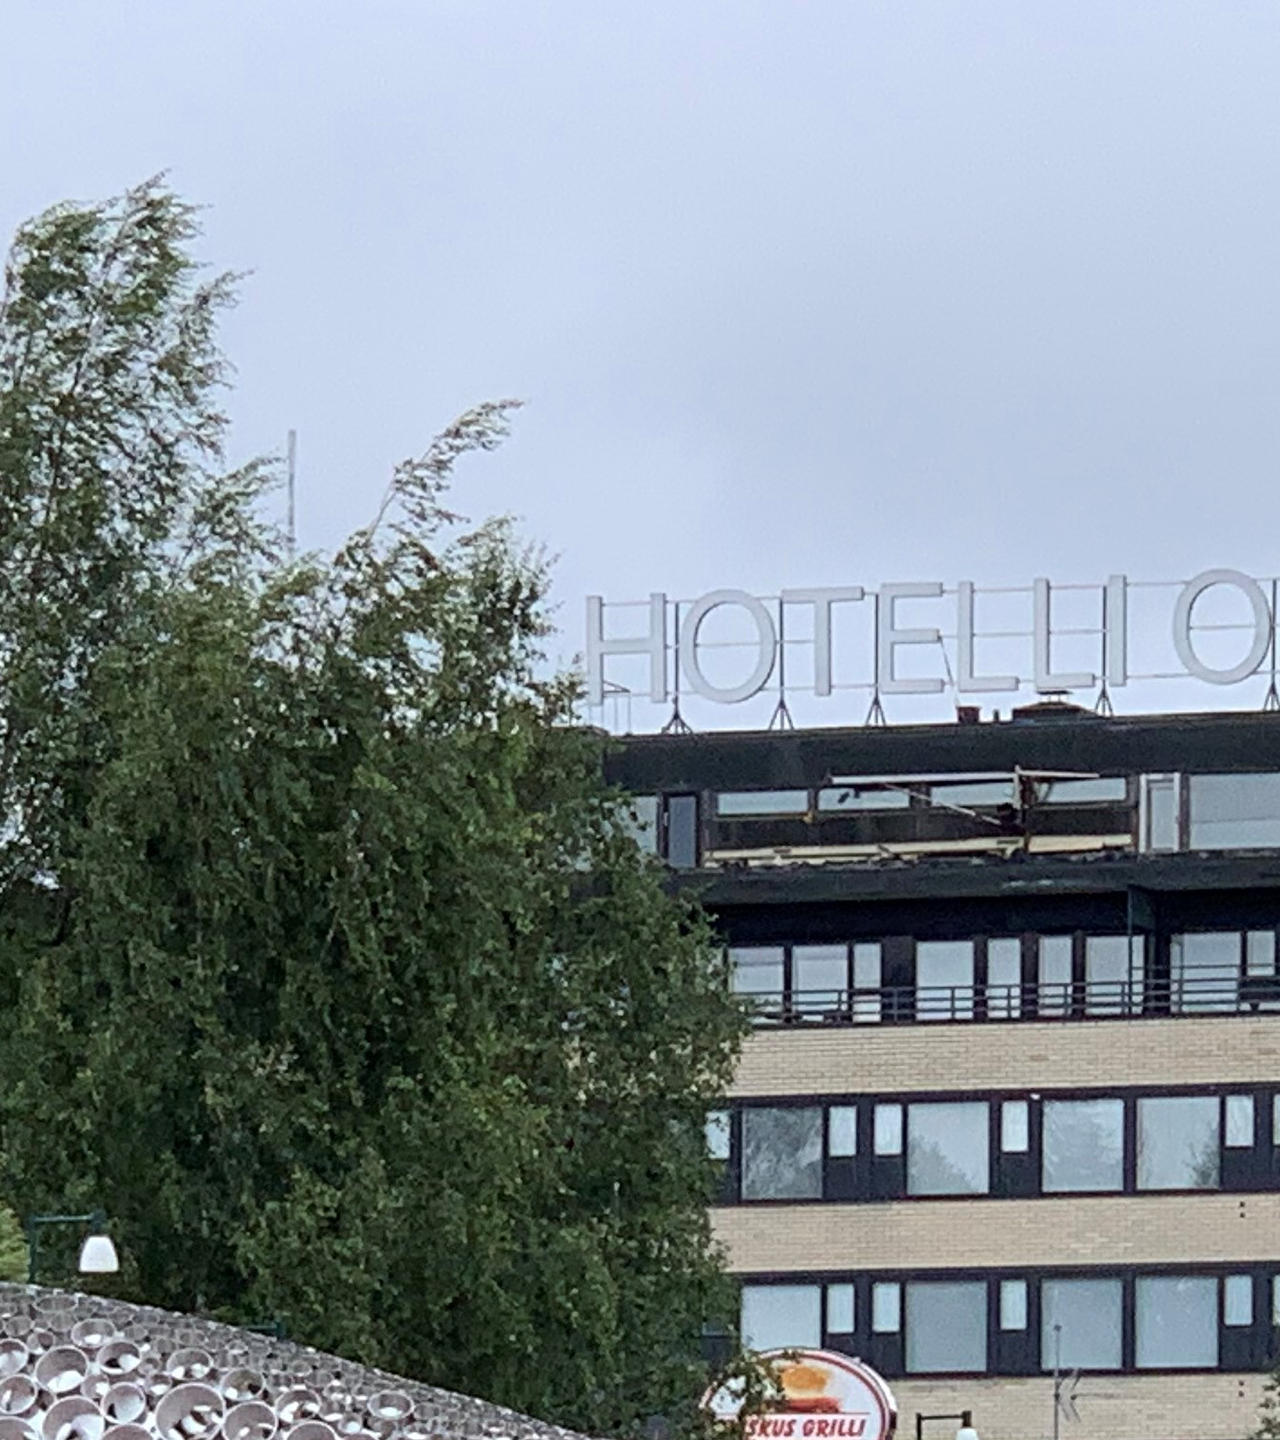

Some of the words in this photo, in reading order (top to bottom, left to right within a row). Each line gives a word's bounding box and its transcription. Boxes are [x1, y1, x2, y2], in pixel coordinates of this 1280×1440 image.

[586, 574, 1128, 705] HOTELLI
[747, 1418, 797, 1438] SKUS
[802, 1418, 867, 1438] GRILLI
